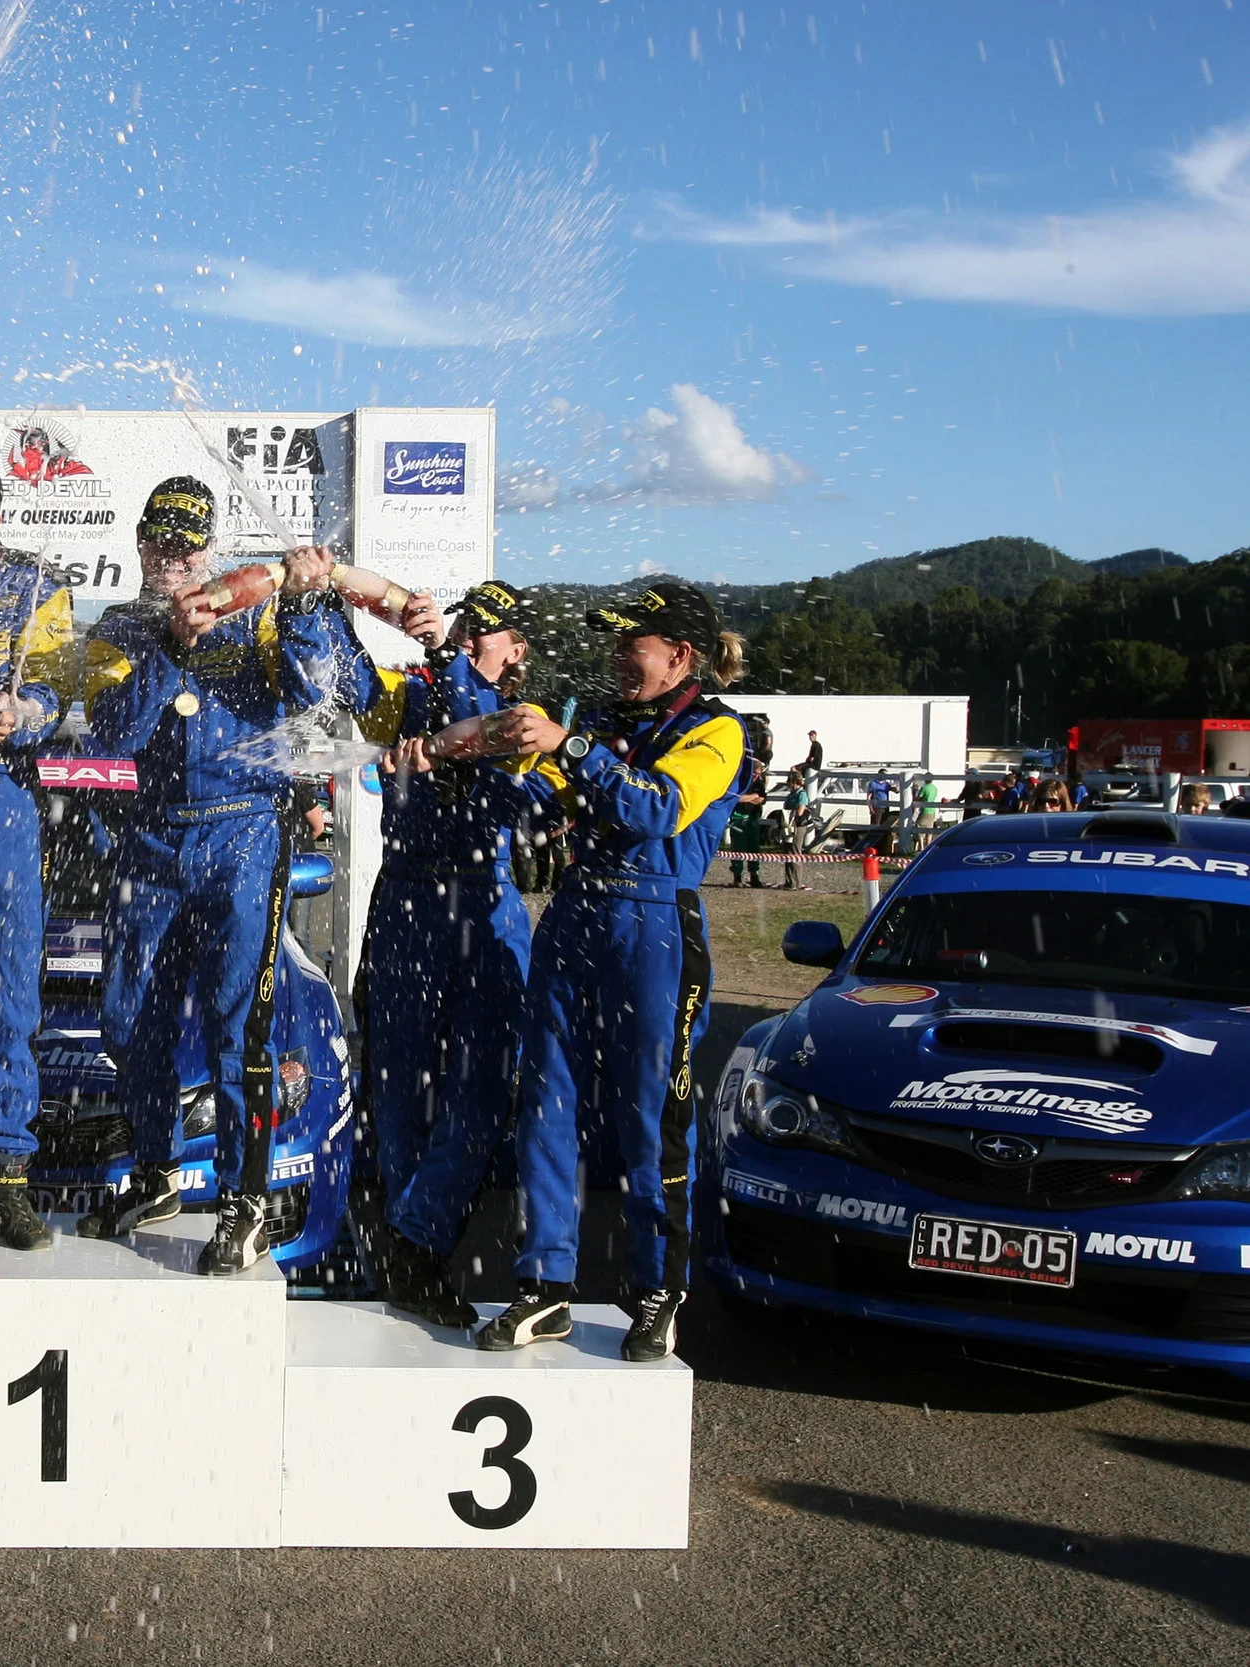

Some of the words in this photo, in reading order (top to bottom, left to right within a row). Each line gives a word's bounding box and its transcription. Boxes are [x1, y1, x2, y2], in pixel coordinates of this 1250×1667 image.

[386, 449, 464, 485] Sunshine
[419, 469, 463, 488] Coast
[0, 478, 31, 497] ED
[35, 479, 112, 498] DEVIL
[228, 478, 326, 492] AA-PACIFIC
[227, 494, 326, 517] RLLY
[381, 499, 407, 513] Find
[410, 504, 435, 520] your
[438, 502, 467, 517] space
[57, 530, 78, 541] May
[80, 530, 104, 540] 2009
[375, 538, 435, 552] Sunshine
[437, 538, 476, 552] Coast
[37, 766, 139, 785] BAR
[204, 800, 252, 816] ATKINSON
[1026, 850, 1249, 877] SUBAR
[268, 887, 283, 964] SUBARU
[682, 984, 701, 1062] SUBARU
[897, 1081, 1153, 1124] MotorImage
[272, 1154, 315, 1182] RELLI
[722, 1167, 788, 1204] PIRELLI
[815, 1193, 908, 1228] MOTUL
[930, 1221, 1003, 1263] RED
[1022, 1234, 1069, 1273] 05
[1084, 1231, 1196, 1264] MOTUL
[917, 1257, 939, 1268] RED
[942, 1261, 975, 1273] DEVIL
[978, 1265, 1027, 1280] ENERGY
[1029, 1271, 1067, 1285] DRINK
[7, 1349, 69, 1483] 1
[448, 1395, 538, 1530] 3
